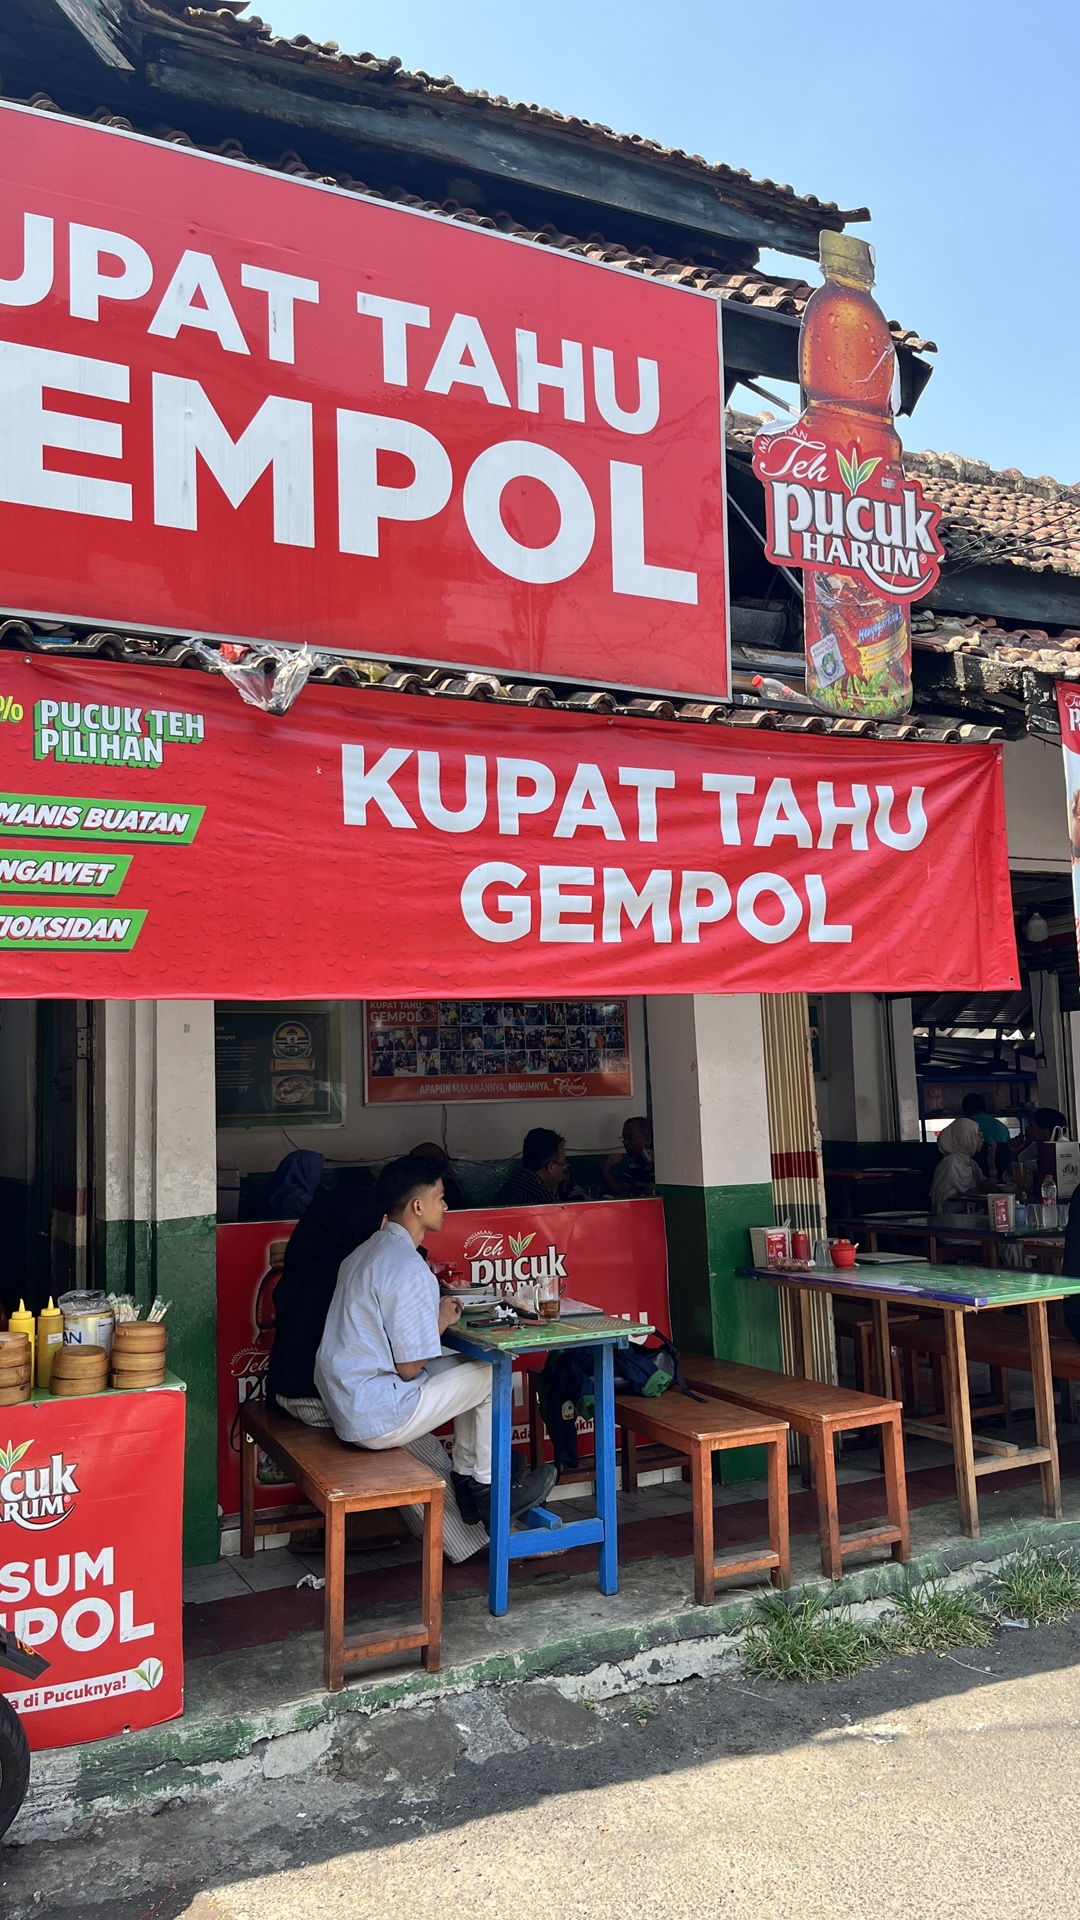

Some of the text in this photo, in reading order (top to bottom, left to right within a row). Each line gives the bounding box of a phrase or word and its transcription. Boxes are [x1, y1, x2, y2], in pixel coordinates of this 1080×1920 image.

[357, 290, 660, 435] TAHU
[758, 427, 808, 454] MIAN
[759, 435, 831, 483] Teh
[0, 339, 698, 606] EMPOL
[770, 480, 937, 558] pucuk
[802, 531, 928, 590] HARUM
[37, 699, 143, 735] PUCUK
[147, 709, 205, 742] TEH
[37, 728, 163, 767] PILIHAN
[341, 743, 928, 852] KUPAT TAHU
[0, 802, 190, 834] MANIS BUATAN
[0, 859, 116, 886] NGAWET
[459, 861, 853, 945] GEMPOL
[370, 1001, 422, 1009] KUPAT TAHU
[370, 1010, 422, 1023] GEMPOL
[420, 1083, 450, 1095] APAPUN
[452, 1081, 507, 1094] MAKANANNYA,
[464, 1233, 504, 1260] Teh
[470, 1245, 568, 1284] pucuk
[230, 1350, 269, 1377] Teh
[0, 1546, 114, 1603] SUM
[0, 1590, 155, 1652] POL
[24, 1693, 39, 1707] di
[43, 1675, 127, 1705] Pucuknya!
